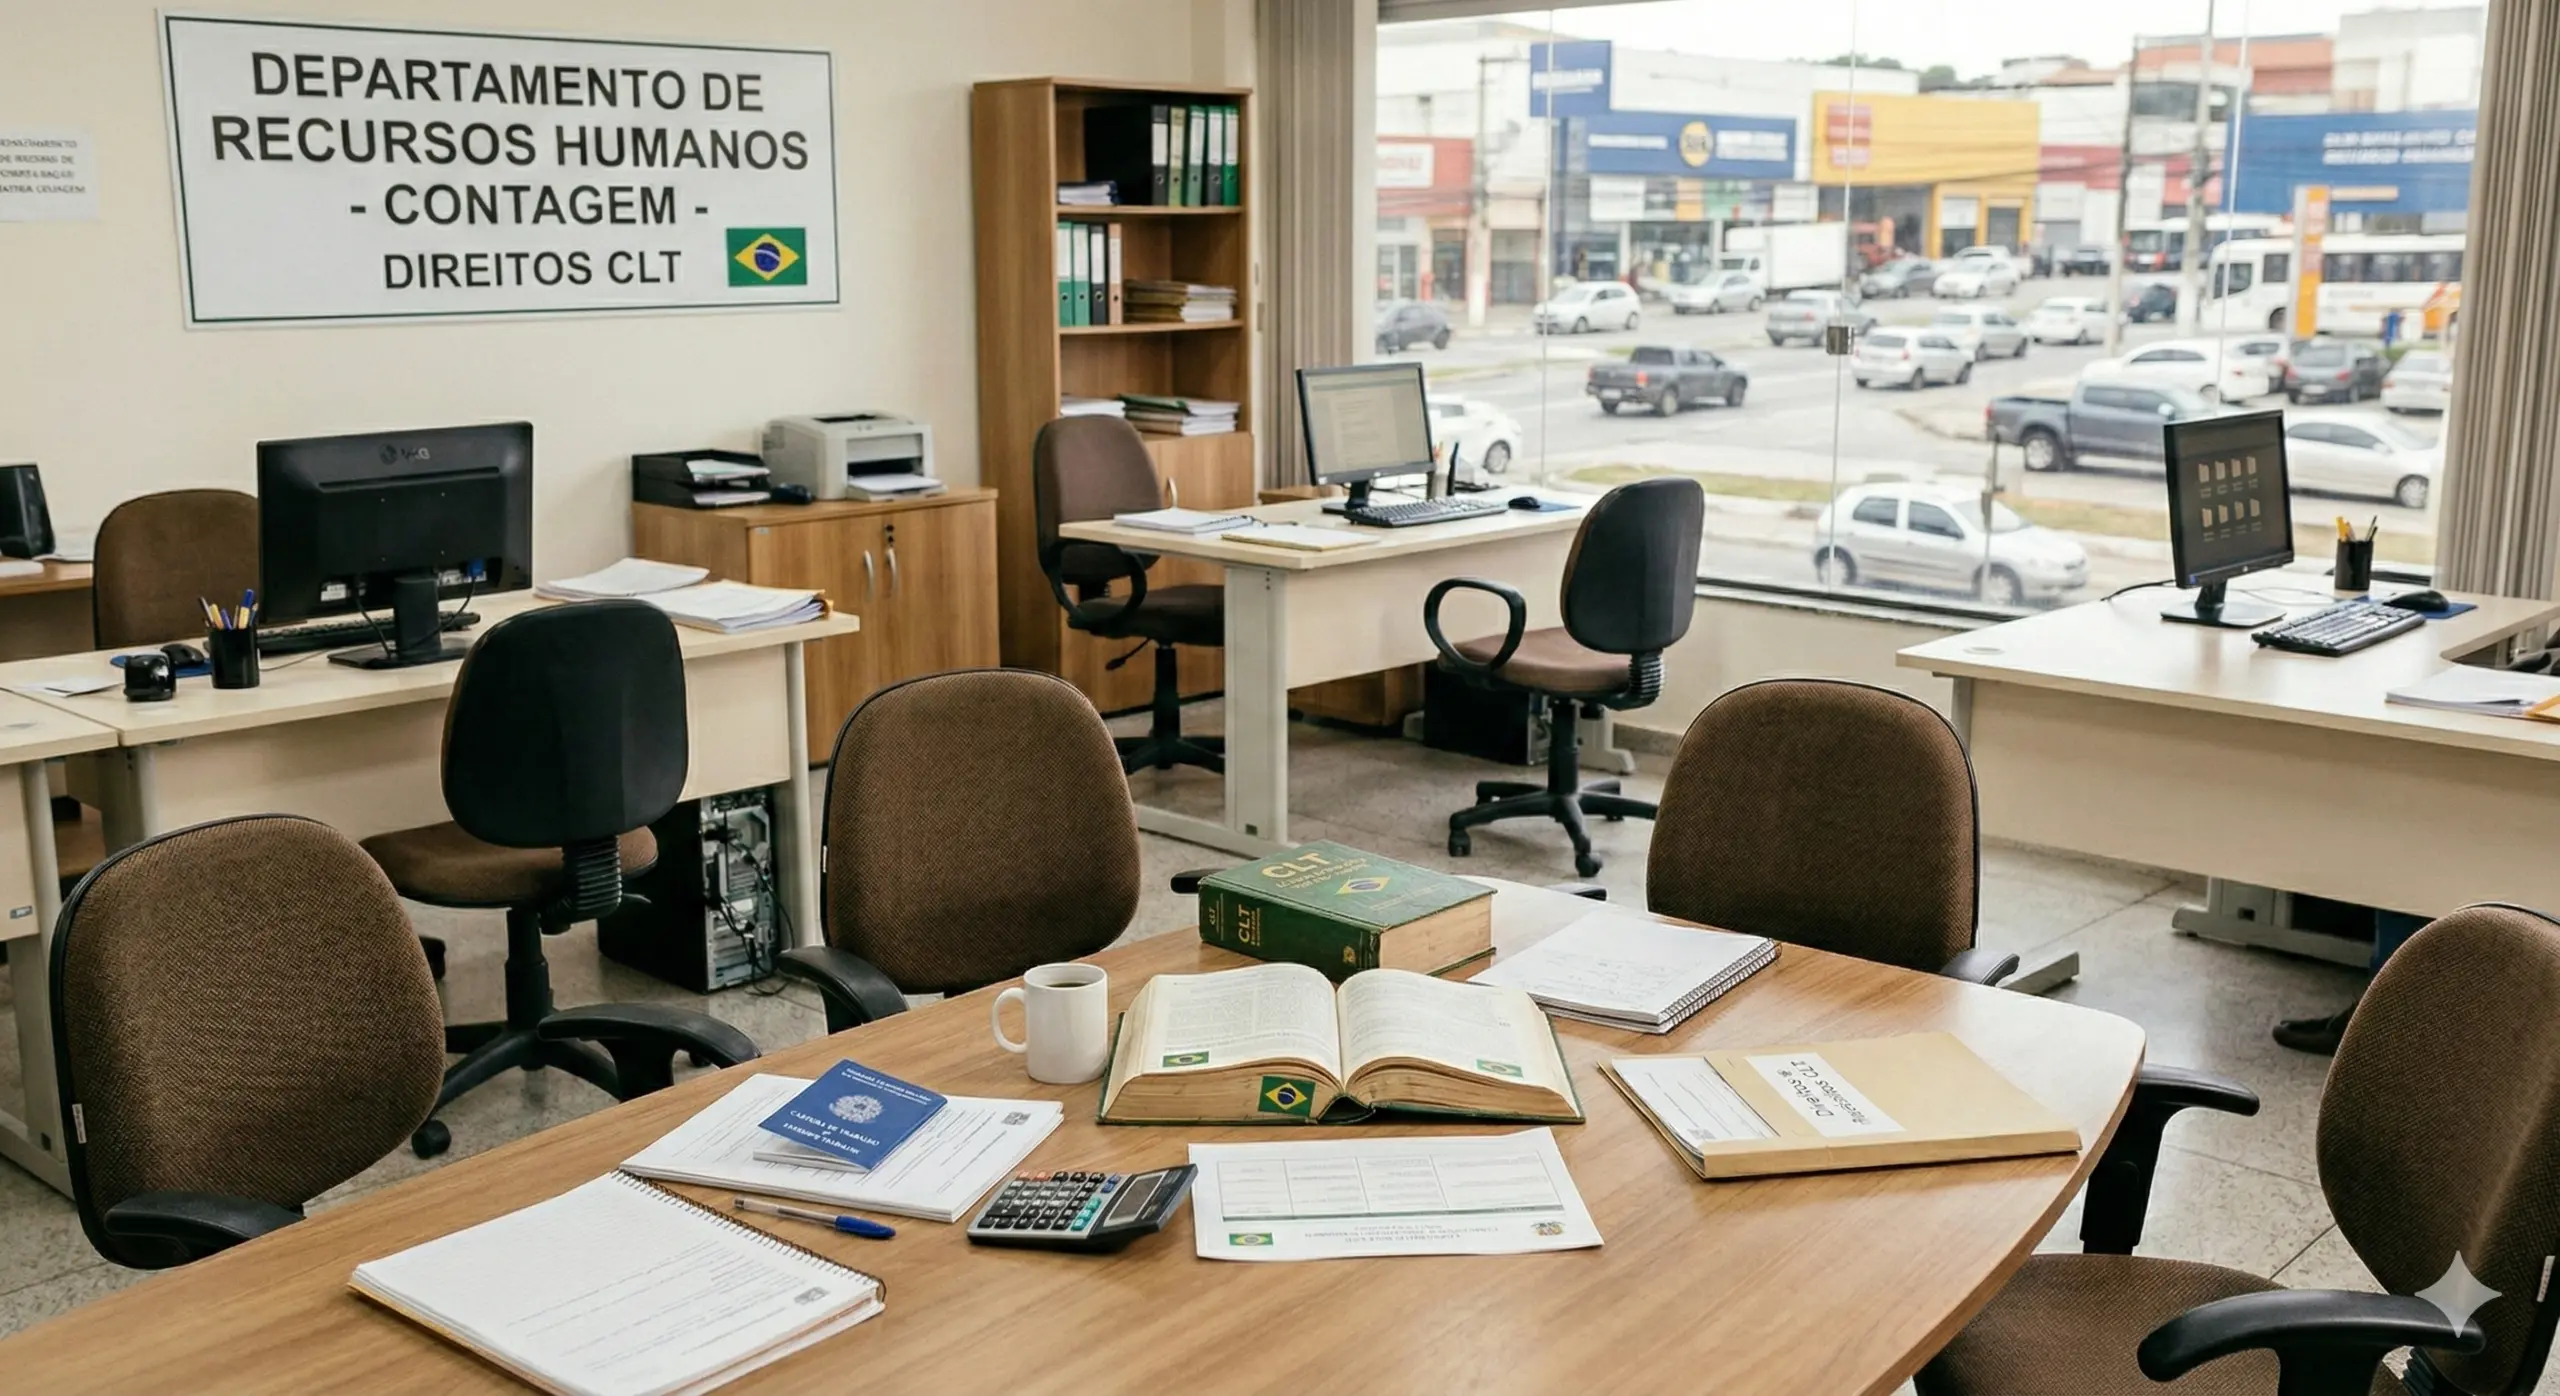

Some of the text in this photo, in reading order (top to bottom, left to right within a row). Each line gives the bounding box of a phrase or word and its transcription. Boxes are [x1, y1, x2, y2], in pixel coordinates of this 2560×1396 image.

[252, 52, 764, 112] DEPARTAMENTO DE
[212, 115, 808, 170] RECURSOS HUMANOS
[385, 183, 676, 225] CONTAGEM
[384, 250, 682, 288] DIREITOS CLT
[1261, 852, 1331, 879] CLT
[1237, 903, 1251, 944] CLT
[1790, 1060, 1819, 1078] CLT
